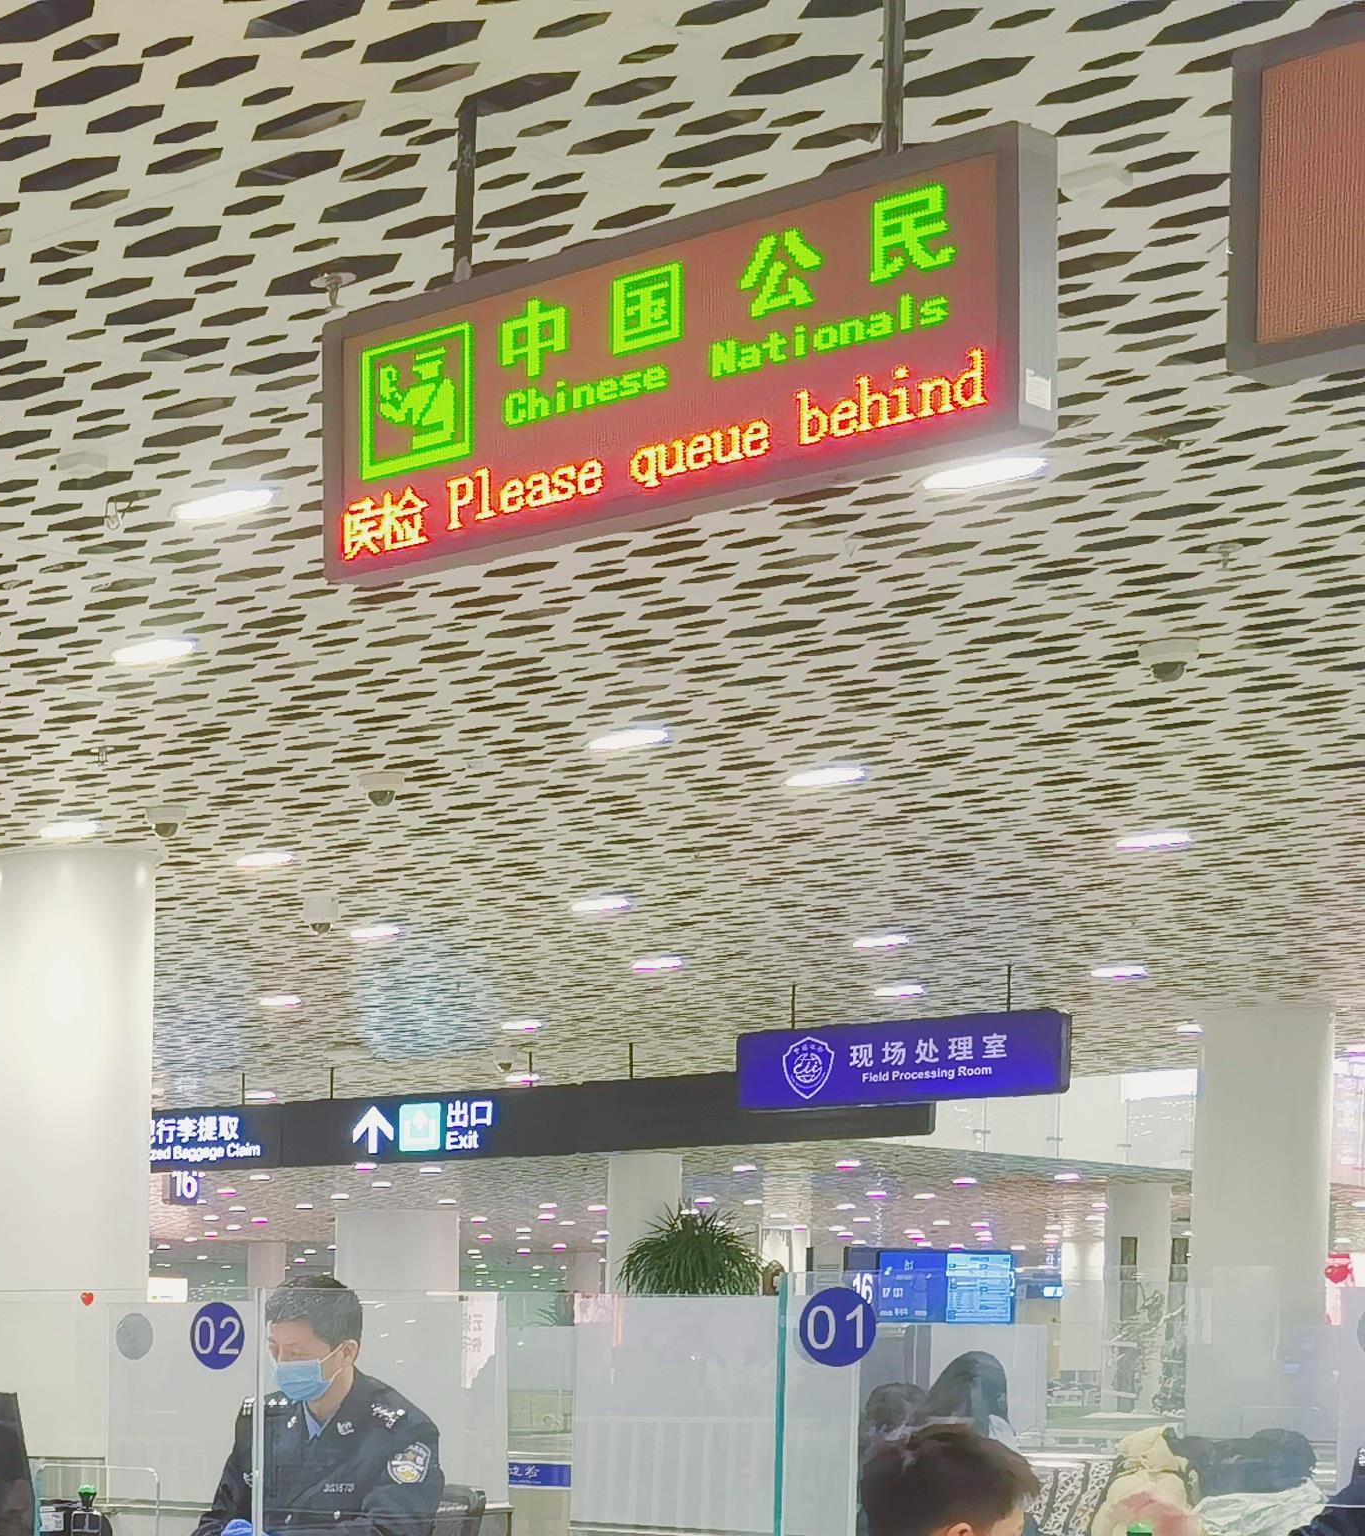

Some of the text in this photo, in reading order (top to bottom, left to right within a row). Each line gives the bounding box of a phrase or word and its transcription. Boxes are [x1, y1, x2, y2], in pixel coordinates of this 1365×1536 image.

[499, 182, 957, 378] 中国公民
[503, 292, 951, 429] Chinese Nationals
[447, 458, 606, 532] Please
[629, 416, 771, 488] queue
[794, 346, 988, 447] behind
[849, 1033, 1009, 1068] 现场处理室
[862, 1065, 992, 1083] Field Processing Room
[446, 1099, 493, 1128] 出口
[173, 1145, 225, 1162] Baggage
[226, 1142, 261, 1157] Claim
[445, 1131, 479, 1150] Exit
[194, 1316, 239, 1355] 02
[807, 1304, 865, 1350] 01
